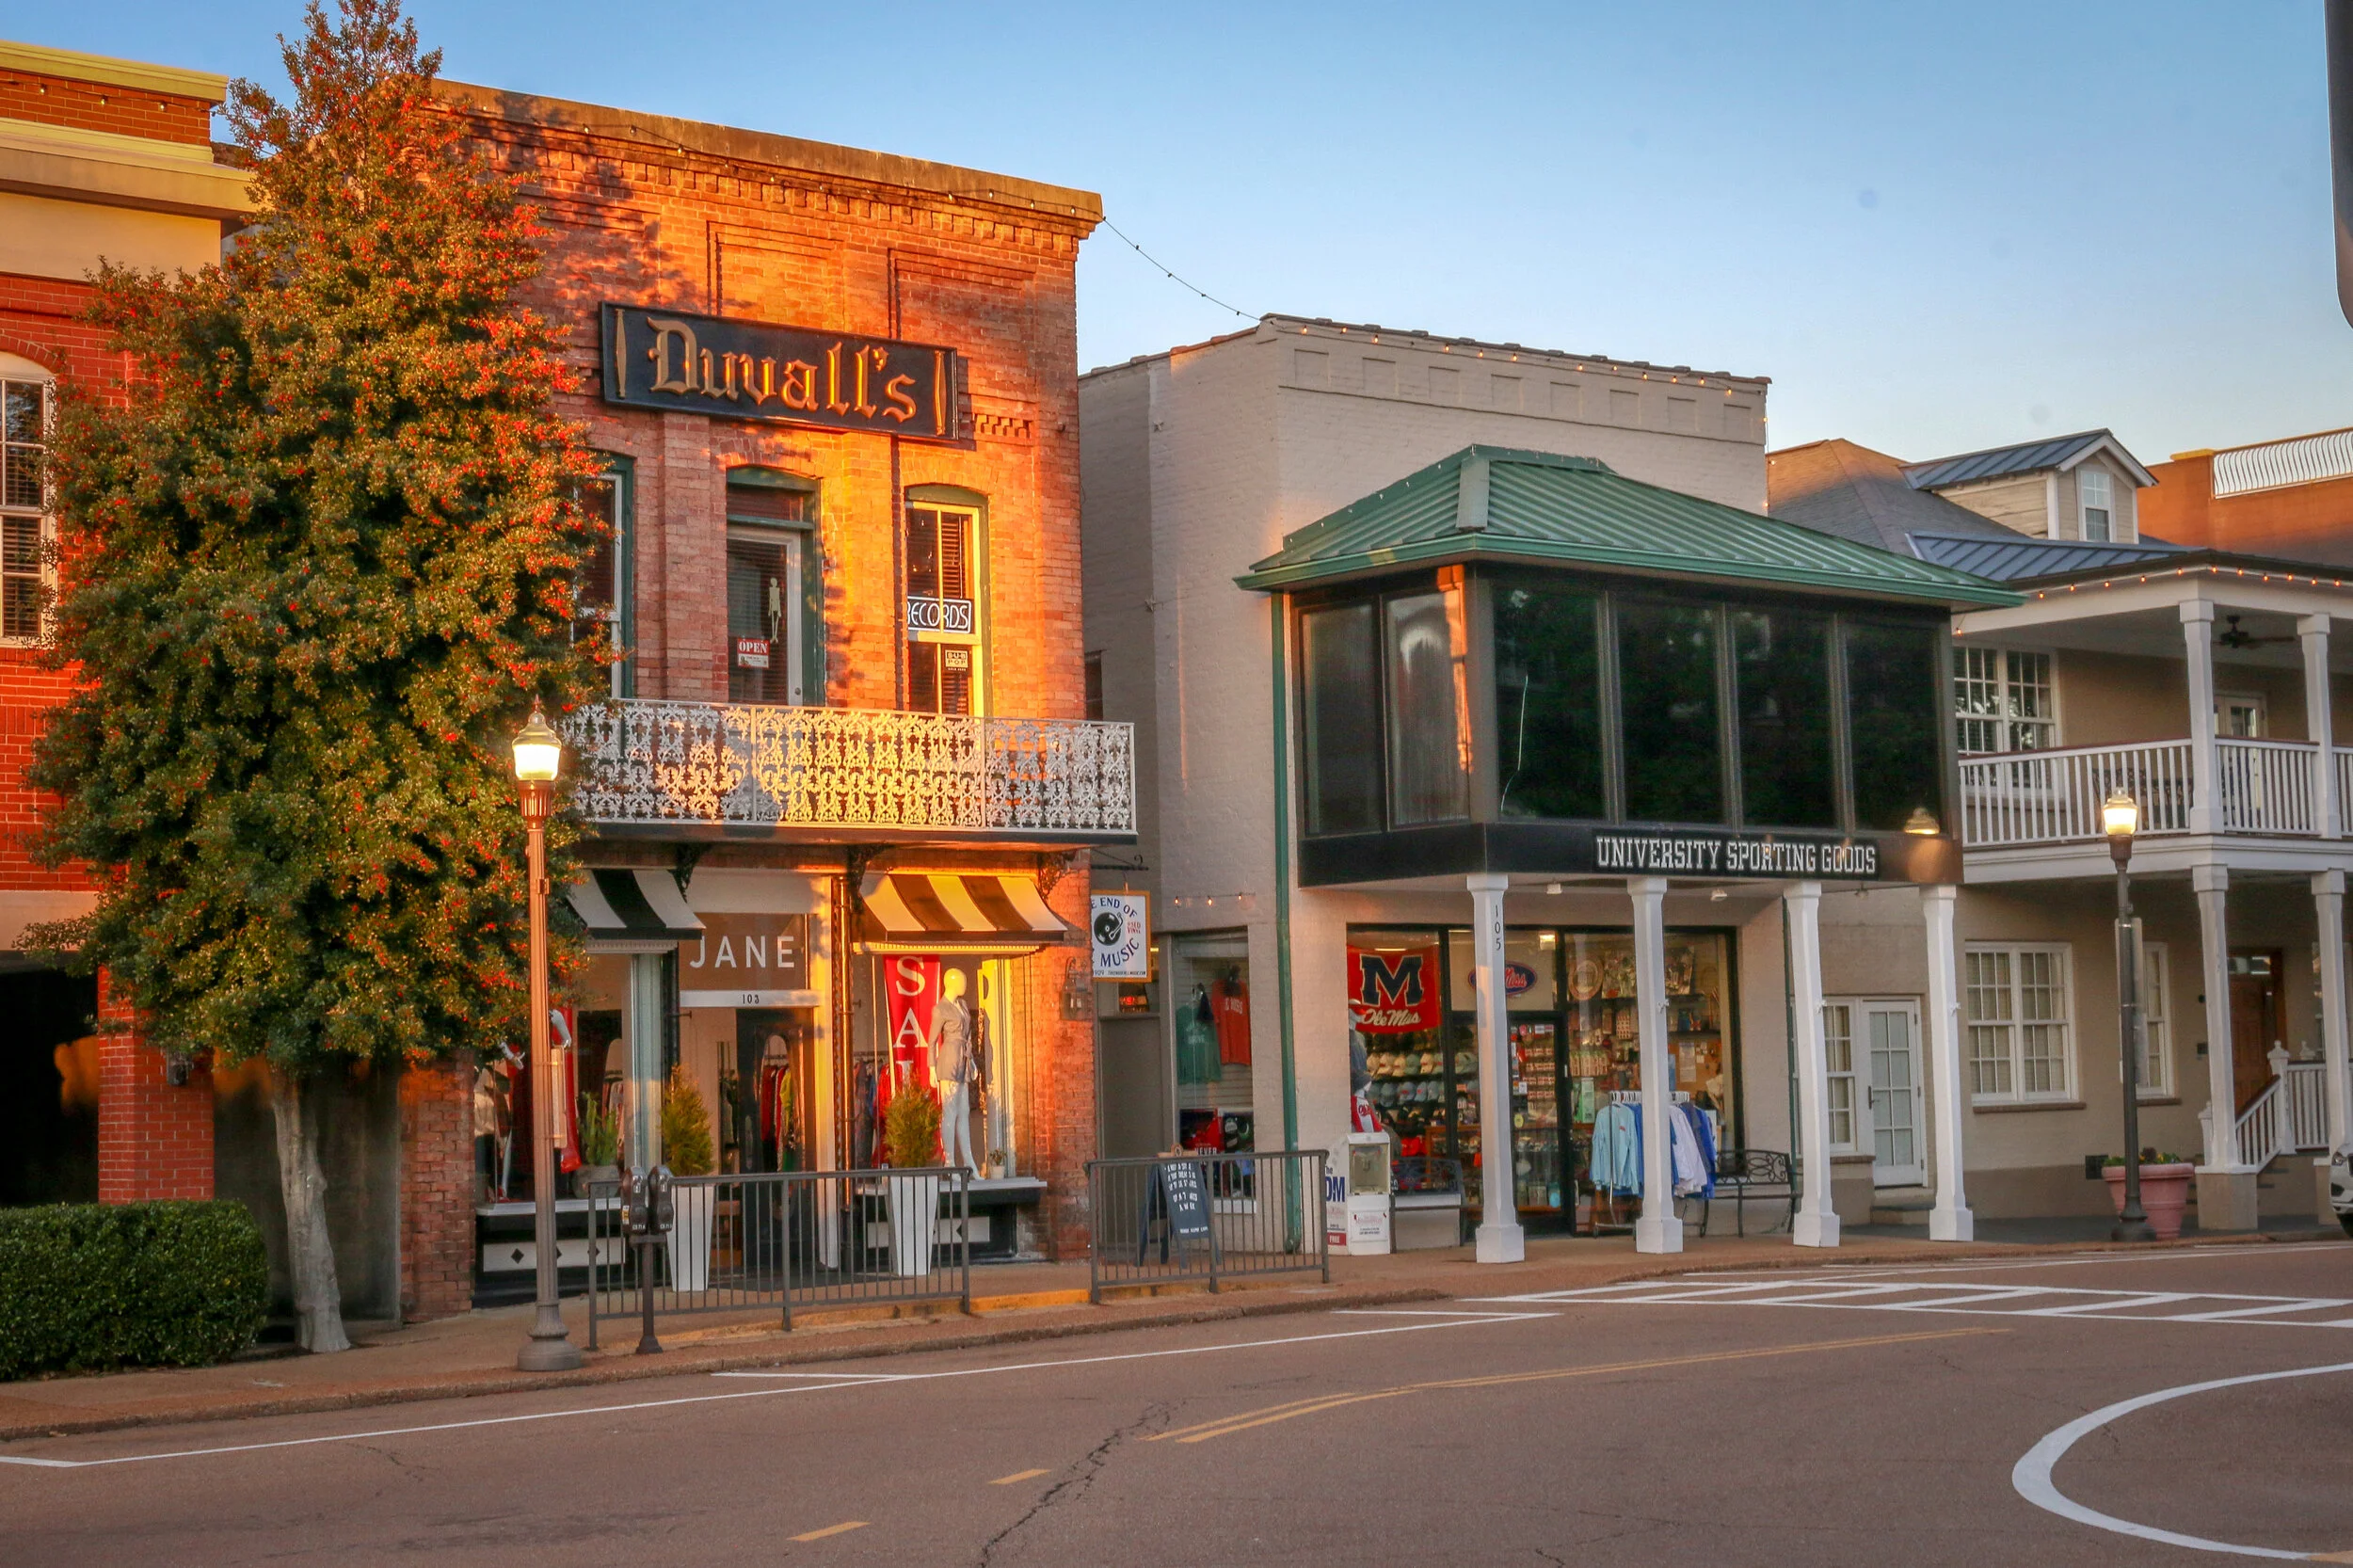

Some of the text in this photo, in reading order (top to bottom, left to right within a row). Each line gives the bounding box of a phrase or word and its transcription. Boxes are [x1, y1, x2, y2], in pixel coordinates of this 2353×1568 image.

[647, 316, 917, 423] Duvall's
[739, 641, 768, 653] OPEN
[1596, 836, 1876, 873] UNIVERSITY SPORTING GOODS
[1099, 897, 1120, 909] END
[1123, 904, 1137, 919] OF
[690, 936, 794, 968] JANE
[1100, 937, 1140, 968] MUSIC
[1360, 954, 1424, 1007] M
[743, 994, 760, 1004] 103
[1362, 1009, 1388, 1026] Ole
